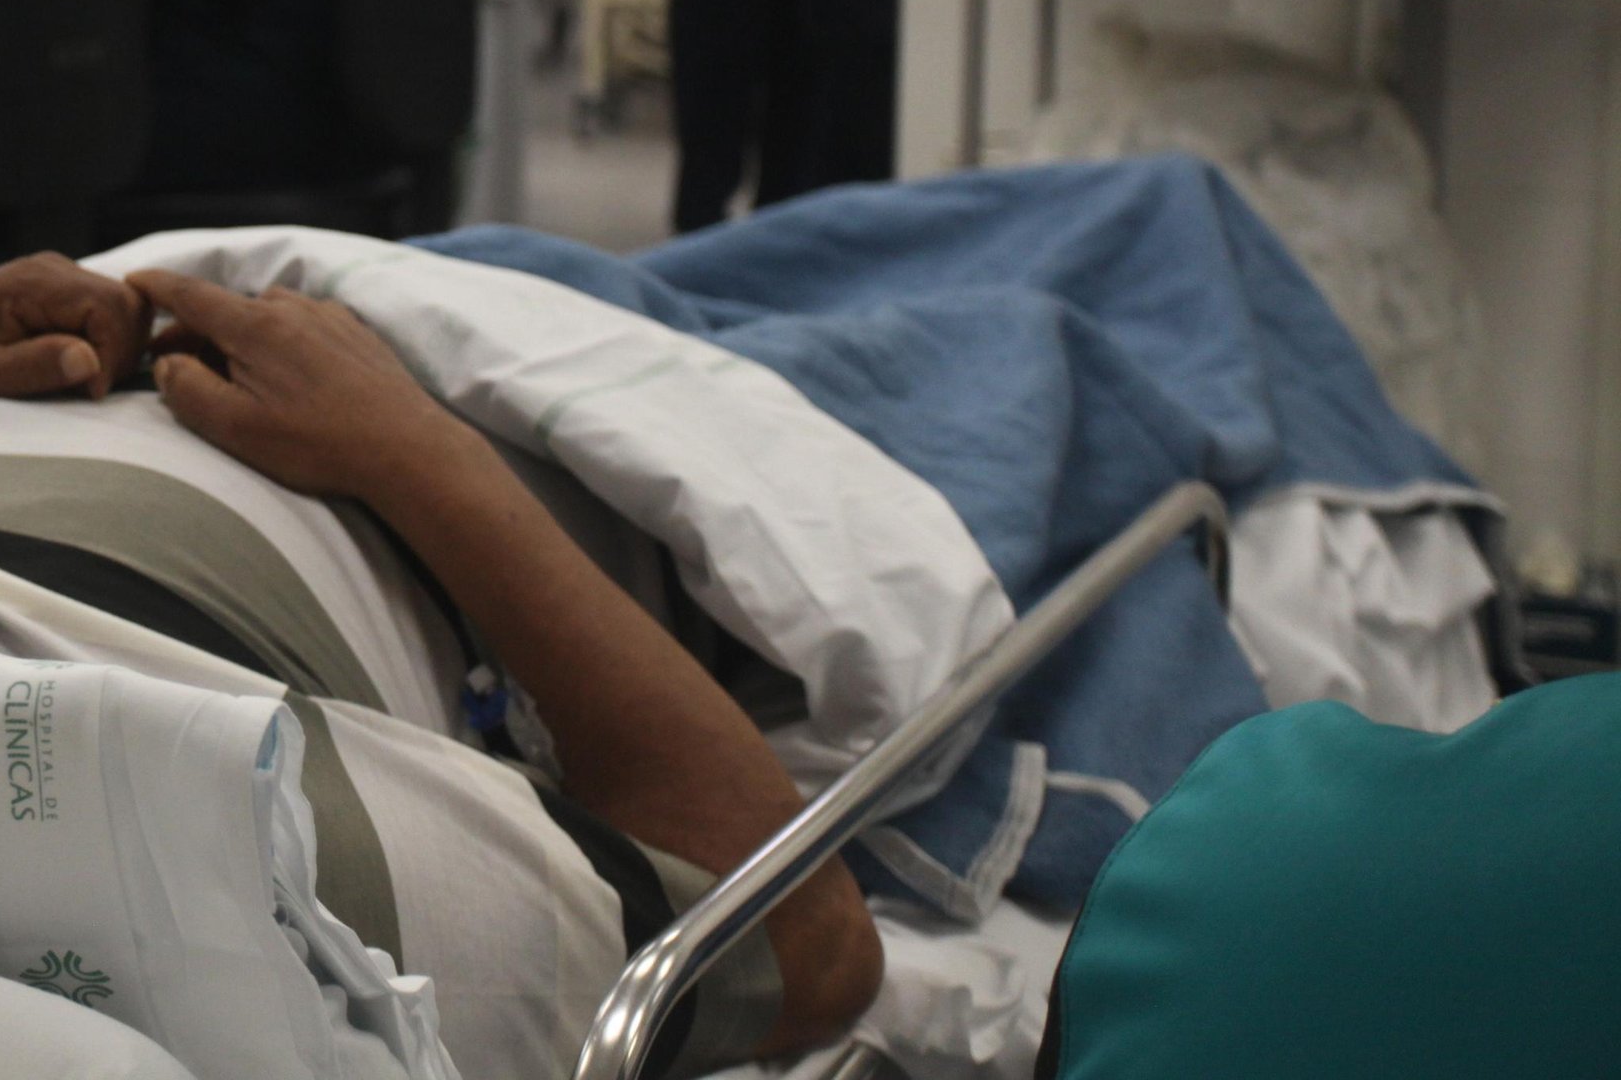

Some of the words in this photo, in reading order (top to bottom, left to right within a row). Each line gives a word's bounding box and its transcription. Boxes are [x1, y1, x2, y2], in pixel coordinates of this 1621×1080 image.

[4, 681, 35, 821] CLÍNICAS
[40, 680, 55, 782] HOSPITAL
[45, 797, 58, 820] DE
